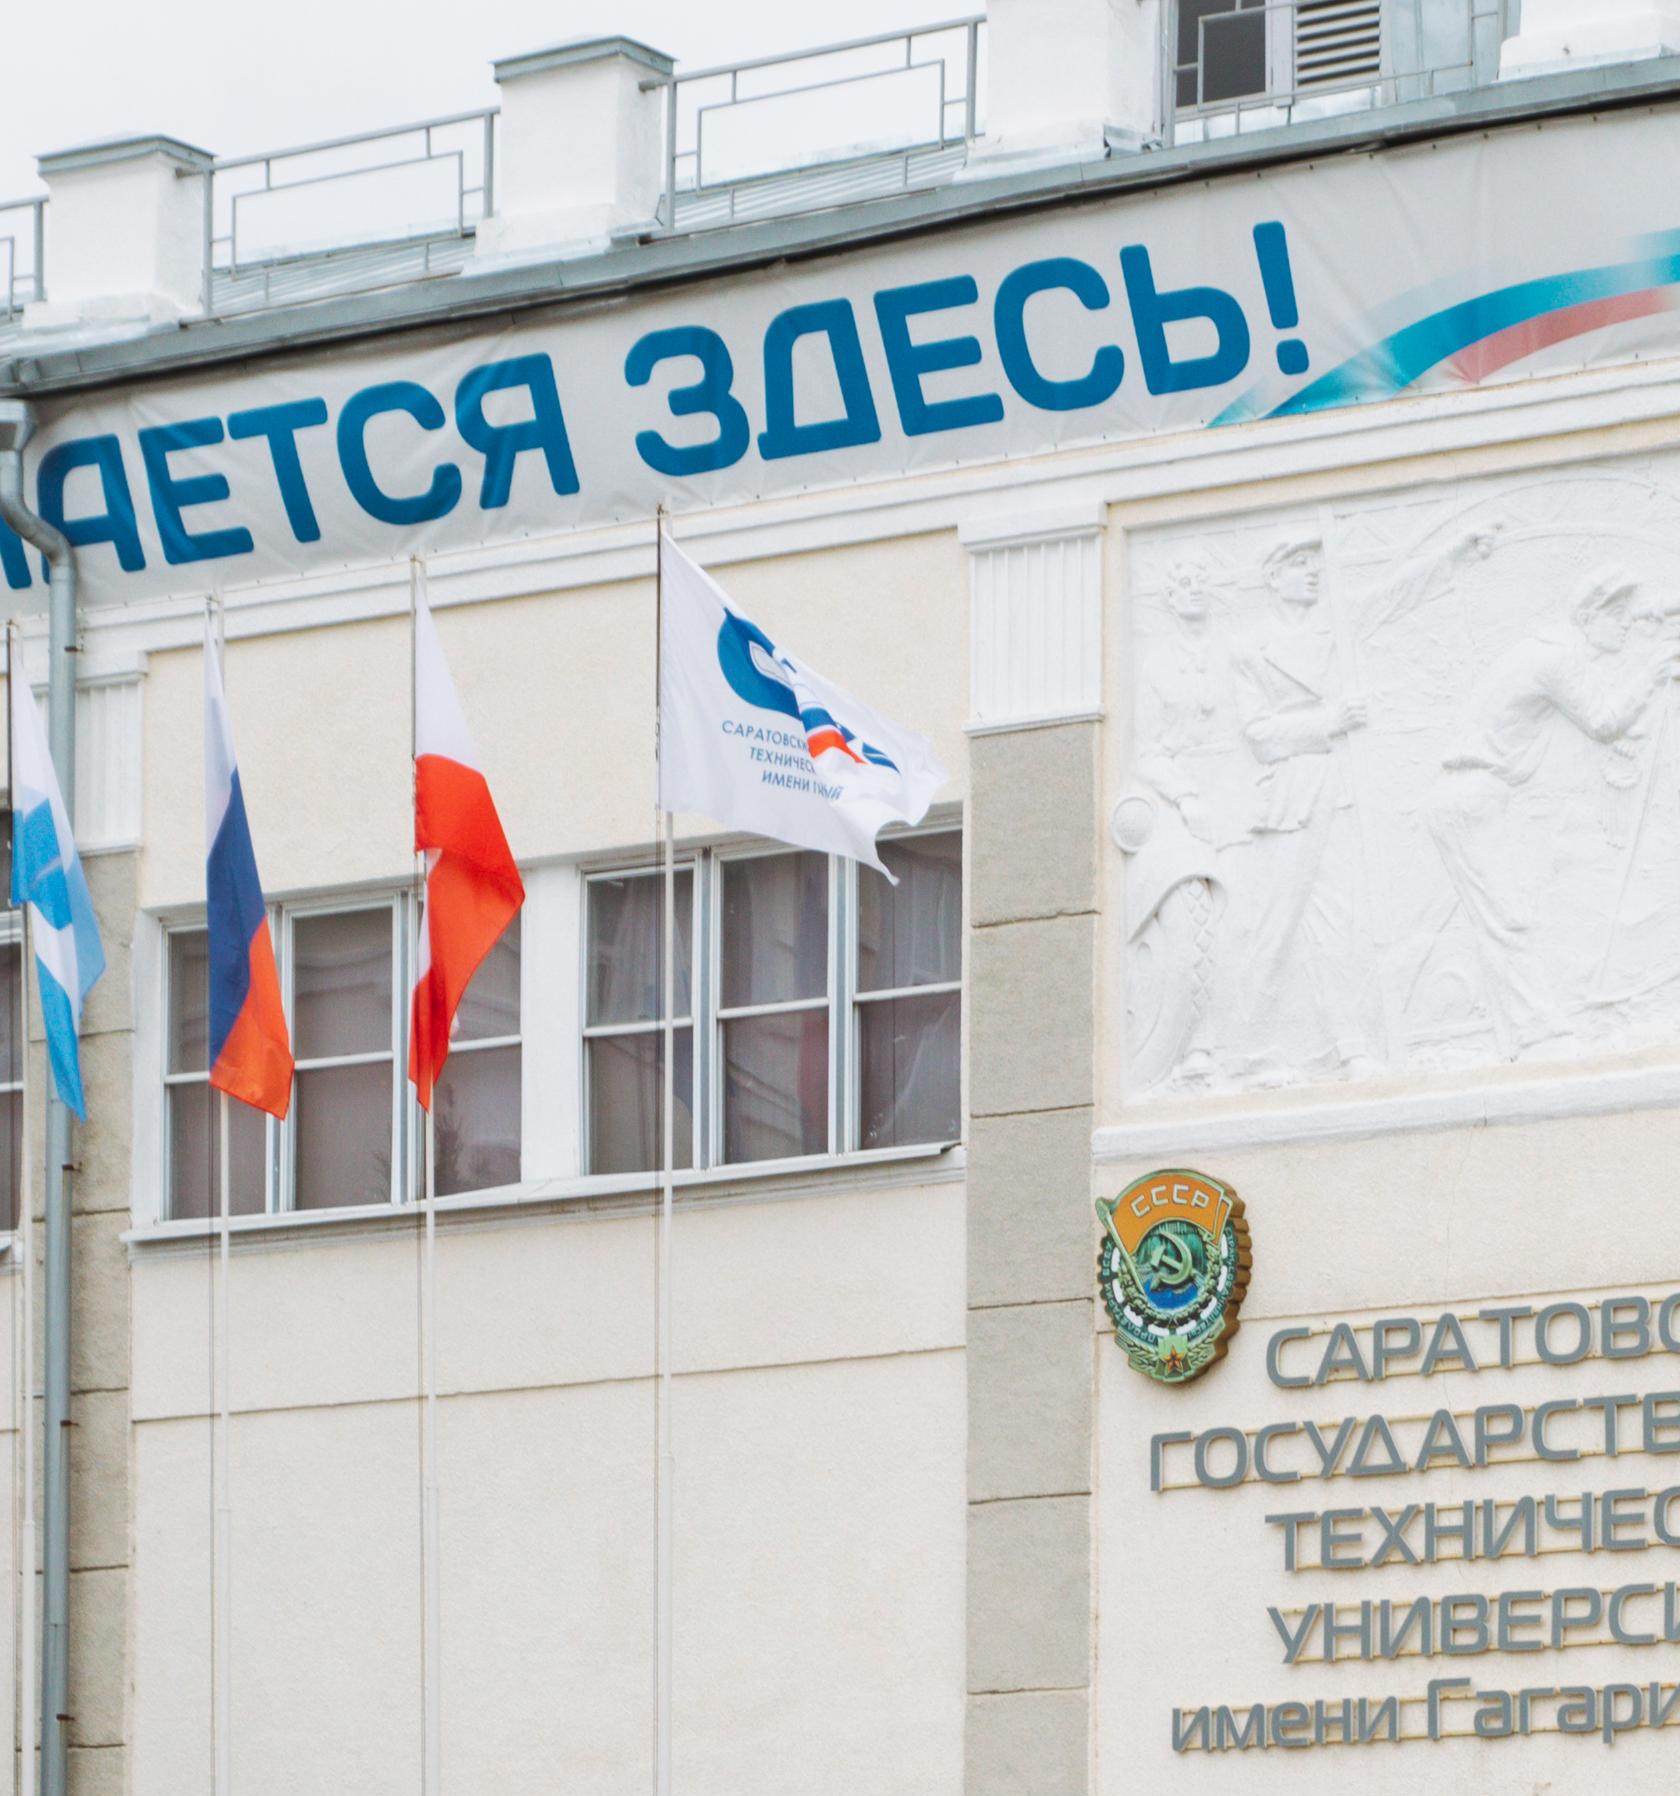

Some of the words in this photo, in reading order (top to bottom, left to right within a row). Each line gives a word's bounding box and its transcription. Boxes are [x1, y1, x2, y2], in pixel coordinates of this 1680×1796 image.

[624, 220, 1310, 476] ЗДЕСЬ!
[1131, 1184, 1209, 1217] СССР
[1172, 1695, 1400, 1753] имени
